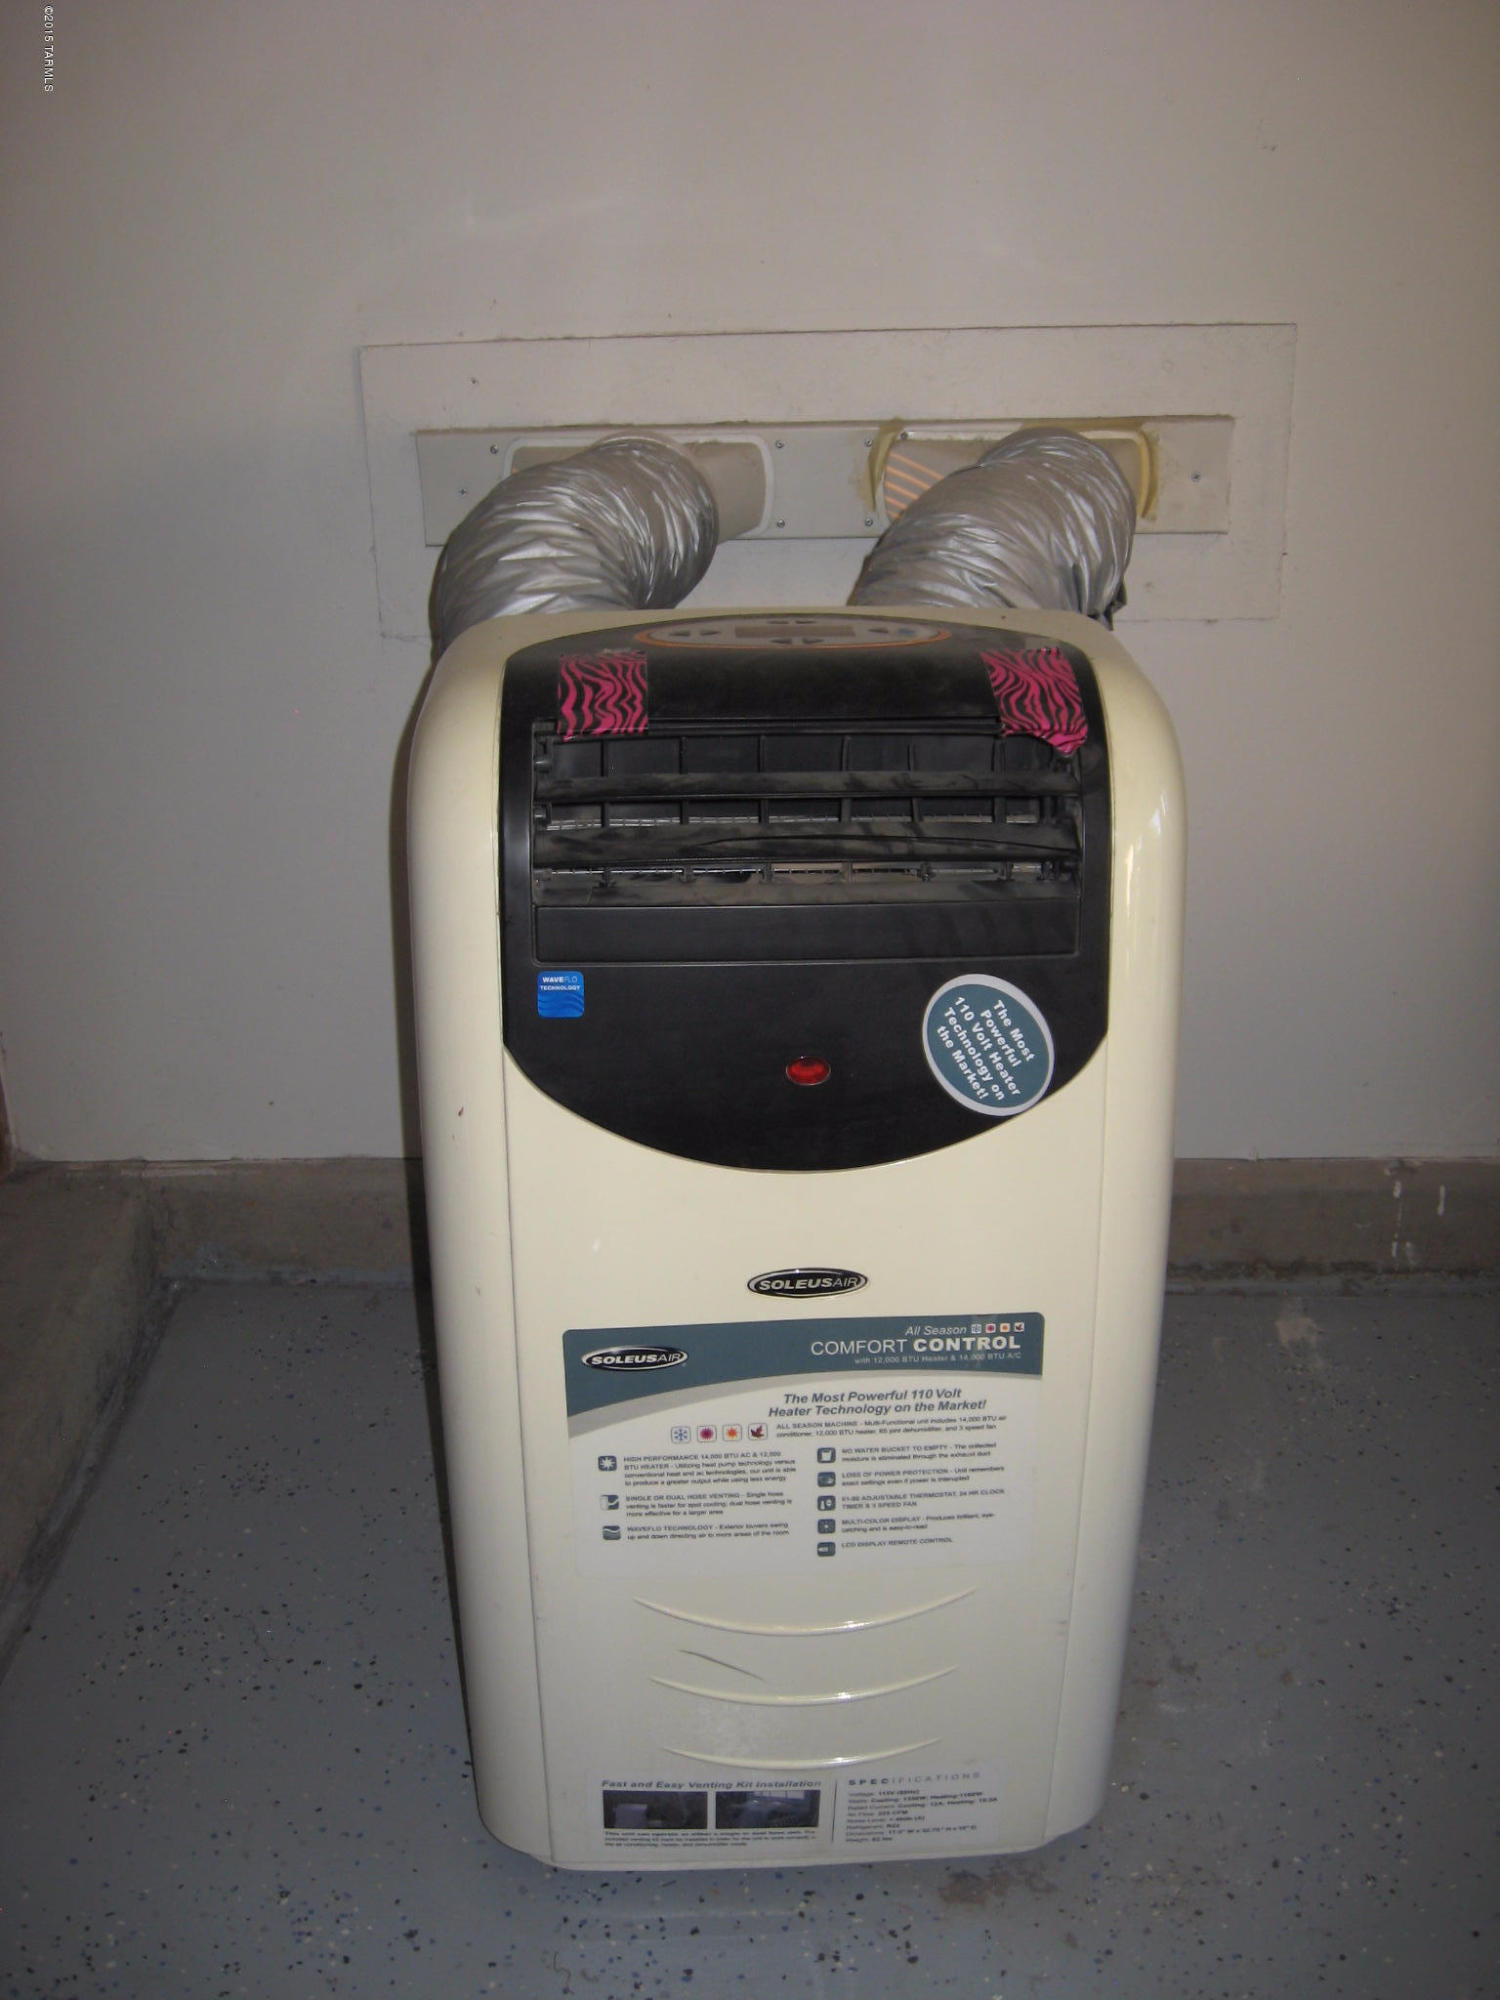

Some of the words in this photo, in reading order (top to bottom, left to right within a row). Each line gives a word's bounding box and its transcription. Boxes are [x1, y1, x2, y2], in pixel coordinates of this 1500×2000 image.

[980, 1009, 1022, 1067] Powerful
[993, 1000, 1012, 1027] The
[1010, 1028, 1035, 1062] Most
[944, 1006, 994, 1082] Technology
[991, 1084, 1005, 1100] on
[954, 996, 975, 1022] 110
[972, 1022, 994, 1051] Volt
[989, 1052, 1021, 1095] Heater
[936, 1026, 954, 1048] the
[952, 1049, 989, 1100] Market!
[759, 1277, 858, 1291] SOLEUSAIR
[904, 1324, 922, 1336] All
[923, 1325, 968, 1336] Season
[811, 1338, 908, 1356] COMFORT
[913, 1336, 1021, 1352] CONTROL
[591, 1353, 682, 1366] SOLEUSAIR
[784, 1394, 809, 1404] The
[811, 1392, 845, 1403] Most
[848, 1390, 908, 1402] Powerful
[912, 1389, 934, 1400] 110
[936, 1388, 962, 1398] Volt
[768, 1406, 812, 1418] Heater
[815, 1404, 892, 1416] Technology
[894, 1404, 912, 1412] on
[914, 1402, 936, 1412] the
[938, 1399, 988, 1411] Market!
[601, 1780, 626, 1788] Fast
[656, 1781, 684, 1789] Easy
[688, 1782, 733, 1790] Venting
[756, 1780, 822, 1788] Installation
[848, 1772, 981, 1786] SPECIFICATIONS
